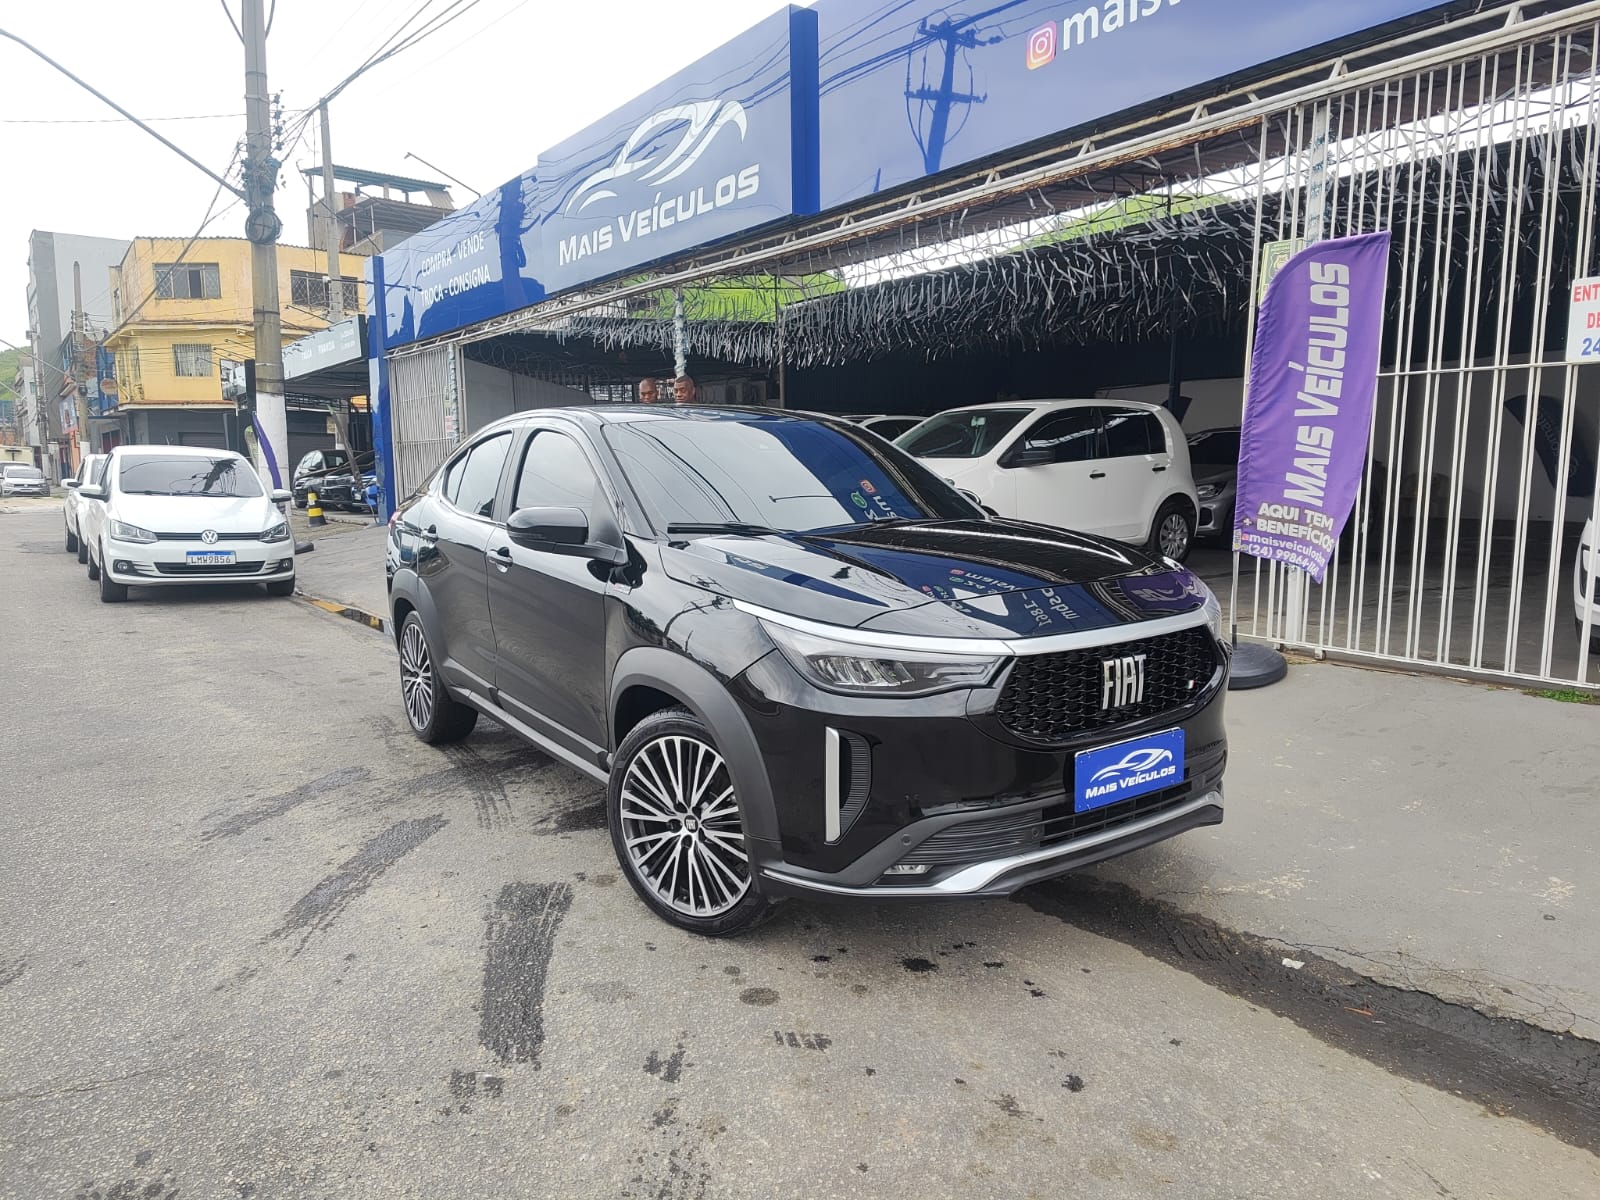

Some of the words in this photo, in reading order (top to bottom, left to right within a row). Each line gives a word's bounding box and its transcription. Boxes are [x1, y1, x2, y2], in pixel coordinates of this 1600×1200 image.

[559, 224, 613, 266] MAIS
[617, 163, 760, 242] VEÍCULOS
[421, 248, 452, 277] COMPRA
[457, 231, 485, 260] VENDE
[420, 283, 444, 307] TROCA
[448, 263, 491, 297] CONSIGNA
[1288, 261, 1350, 417] VEÍCULOS
[1283, 425, 1335, 508] MAIS
[1256, 518, 1335, 553] BENEFÍCIOS
[1258, 502, 1299, 521] AQUI
[1304, 509, 1334, 531] TEM
[1248, 543, 1273, 558] (24)
[1102, 654, 1147, 710] FIAT
[1085, 782, 1118, 800] MAIS
[1119, 765, 1176, 789] VEÍCULOS
